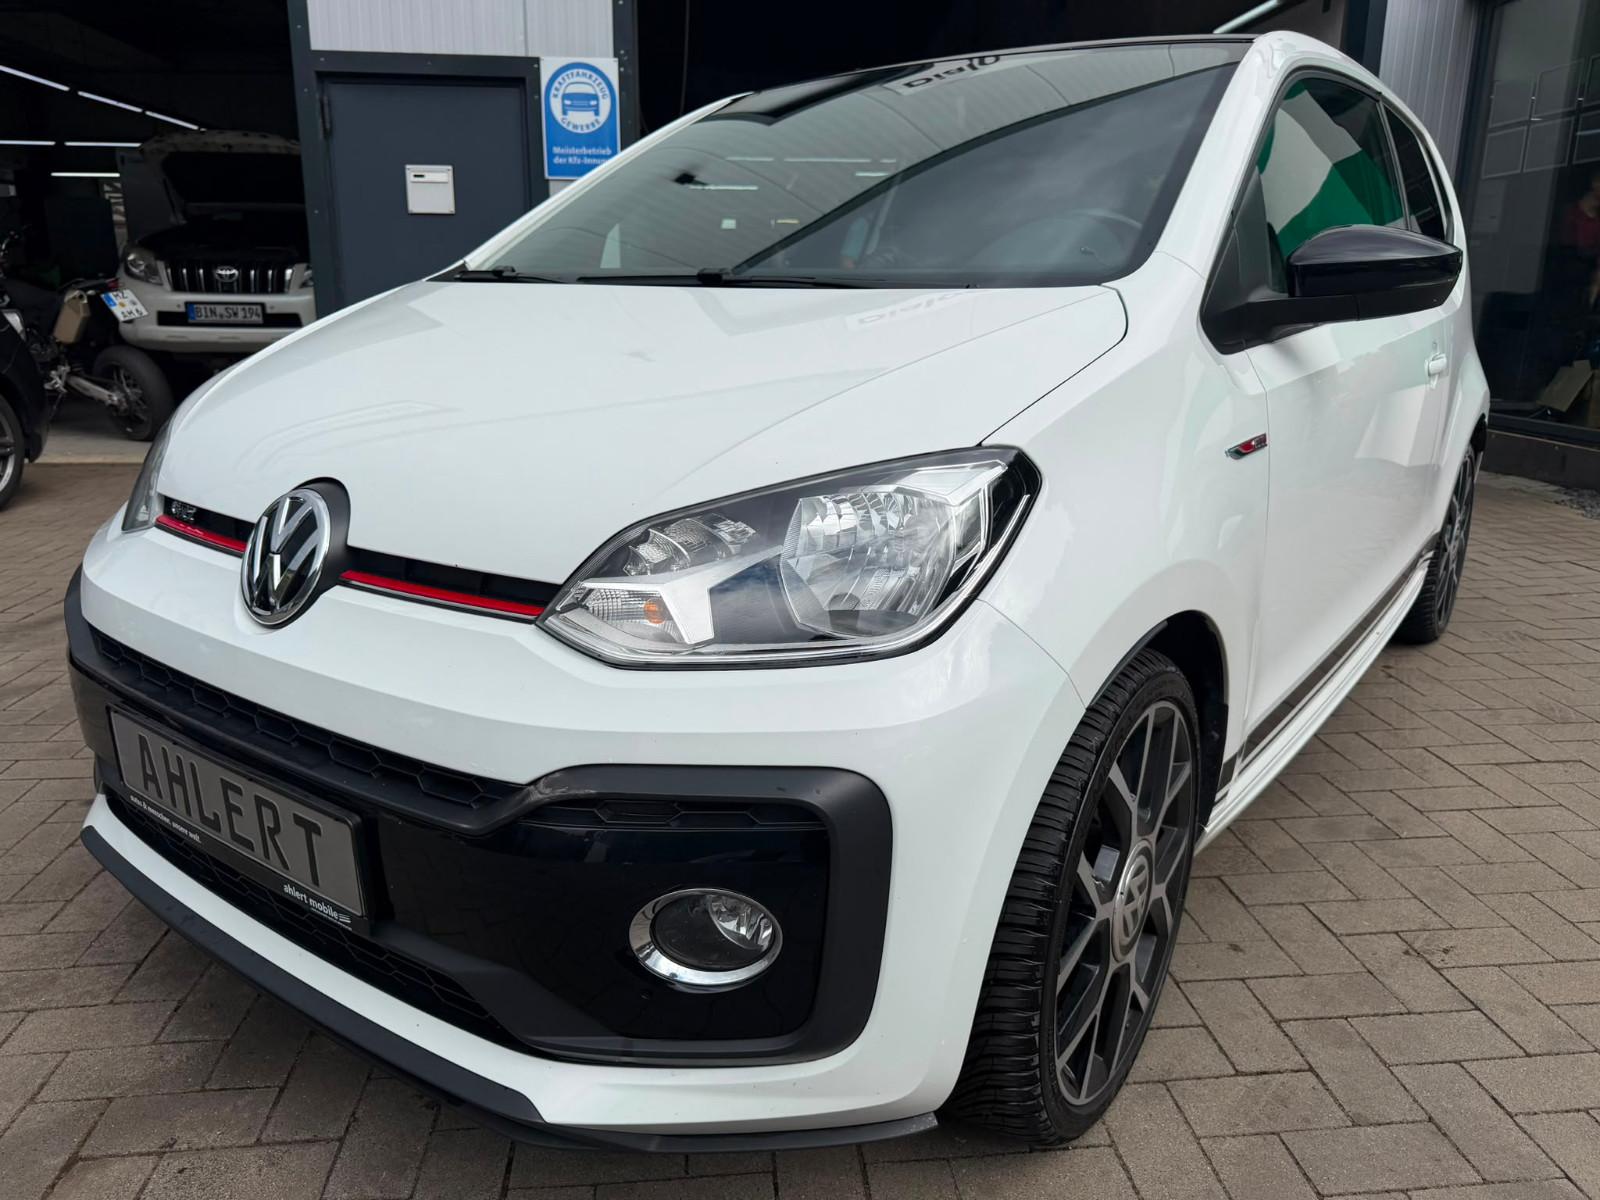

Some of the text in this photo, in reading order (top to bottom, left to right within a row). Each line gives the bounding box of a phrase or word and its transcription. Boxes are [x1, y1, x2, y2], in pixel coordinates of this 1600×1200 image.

[552, 70, 609, 99] KRAFTFAHRZEUG
[560, 116, 602, 132] GEWERBE
[552, 145, 612, 155] Meisterbetrieb
[553, 156, 566, 164] der
[195, 306, 261, 319] BIN SW 194
[138, 733, 322, 888] AHLERT
[283, 884, 308, 904] ahlert
[309, 898, 339, 920] mobile
